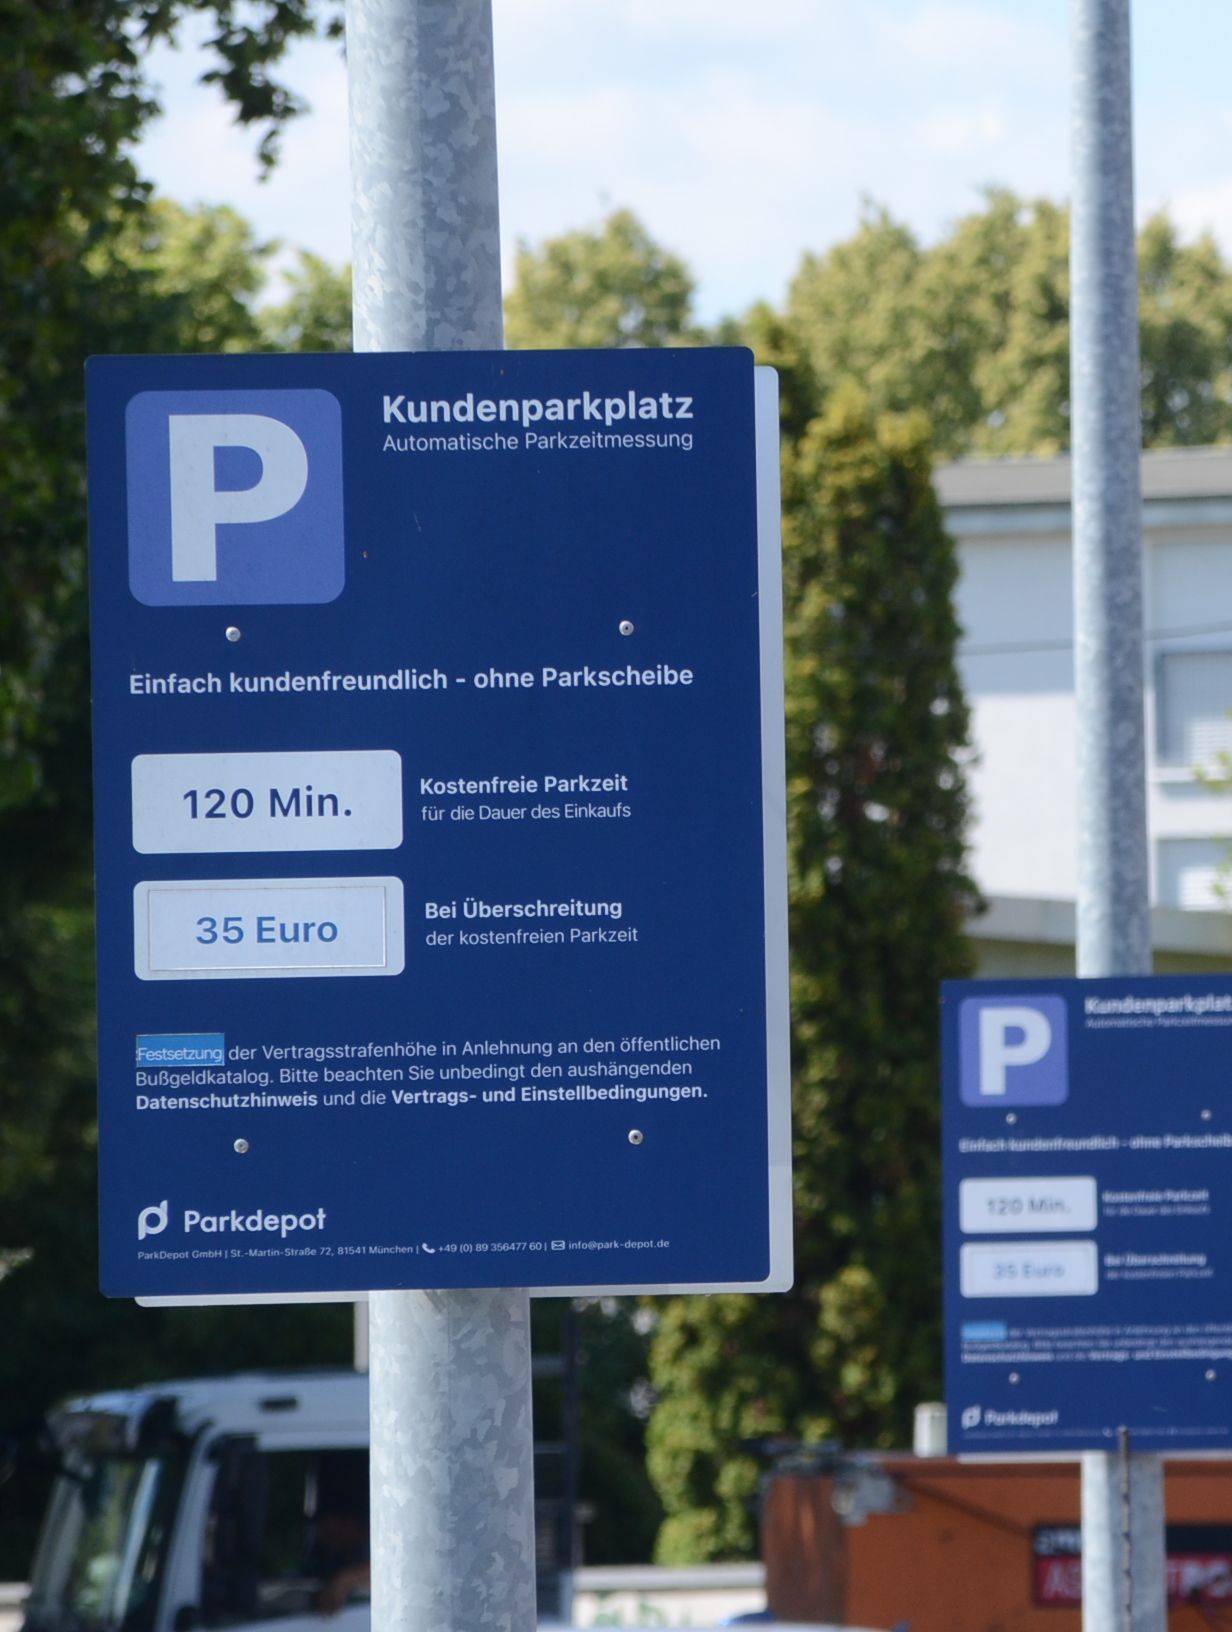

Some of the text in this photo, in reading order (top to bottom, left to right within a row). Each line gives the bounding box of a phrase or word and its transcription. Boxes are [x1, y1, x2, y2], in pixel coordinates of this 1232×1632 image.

[384, 391, 693, 427] Kundenparkplatz
[383, 431, 692, 451] Automatische Parkzeitmessung
[169, 414, 308, 581] P
[130, 673, 221, 694] Einfach
[230, 669, 447, 692] kundenfreundlich
[474, 668, 534, 688] ohne
[543, 665, 693, 687] Parkscheibe
[421, 774, 627, 794] Kostenfreie Parkzeit
[184, 785, 351, 818] 120 Min.
[422, 802, 631, 821] für die Dauer des Einkaufs
[426, 898, 622, 919] Bei Überschreitung
[197, 917, 337, 944] 35 Euro
[426, 927, 638, 945] der kostenfreien Parkzeit
[139, 1036, 720, 1062] Festsetzung der Vertragsstrafenhöhe in Anlehnung an den öffentlichen
[978, 1006, 1052, 1095] P
[136, 1060, 692, 1088] Bußgeldkatalog. Bitte beachten Sie unbedingt den aushängenden
[137, 1085, 707, 1109] Datenschutzhinweis und die Vertrags- und Einstellbedingungen.
[987, 1196, 1071, 1215] 120 Min.
[185, 1208, 326, 1238] Parkdepot
[138, 1251, 188, 1260] ParkDepot
[192, 1250, 222, 1258] GmbH
[231, 1247, 316, 1257] St.-Martin-Straße
[320, 1247, 334, 1256] 72,
[338, 1246, 365, 1255] 81541
[369, 1246, 413, 1254] München
[439, 1244, 457, 1252] +49
[460, 1244, 472, 1253] (0)
[476, 1243, 488, 1251] 89
[491, 1242, 527, 1251] 356477
[529, 1242, 542, 1250] 60
[569, 1240, 669, 1250] info@park-depot.de
[993, 1261, 1064, 1280] 35 Euro
